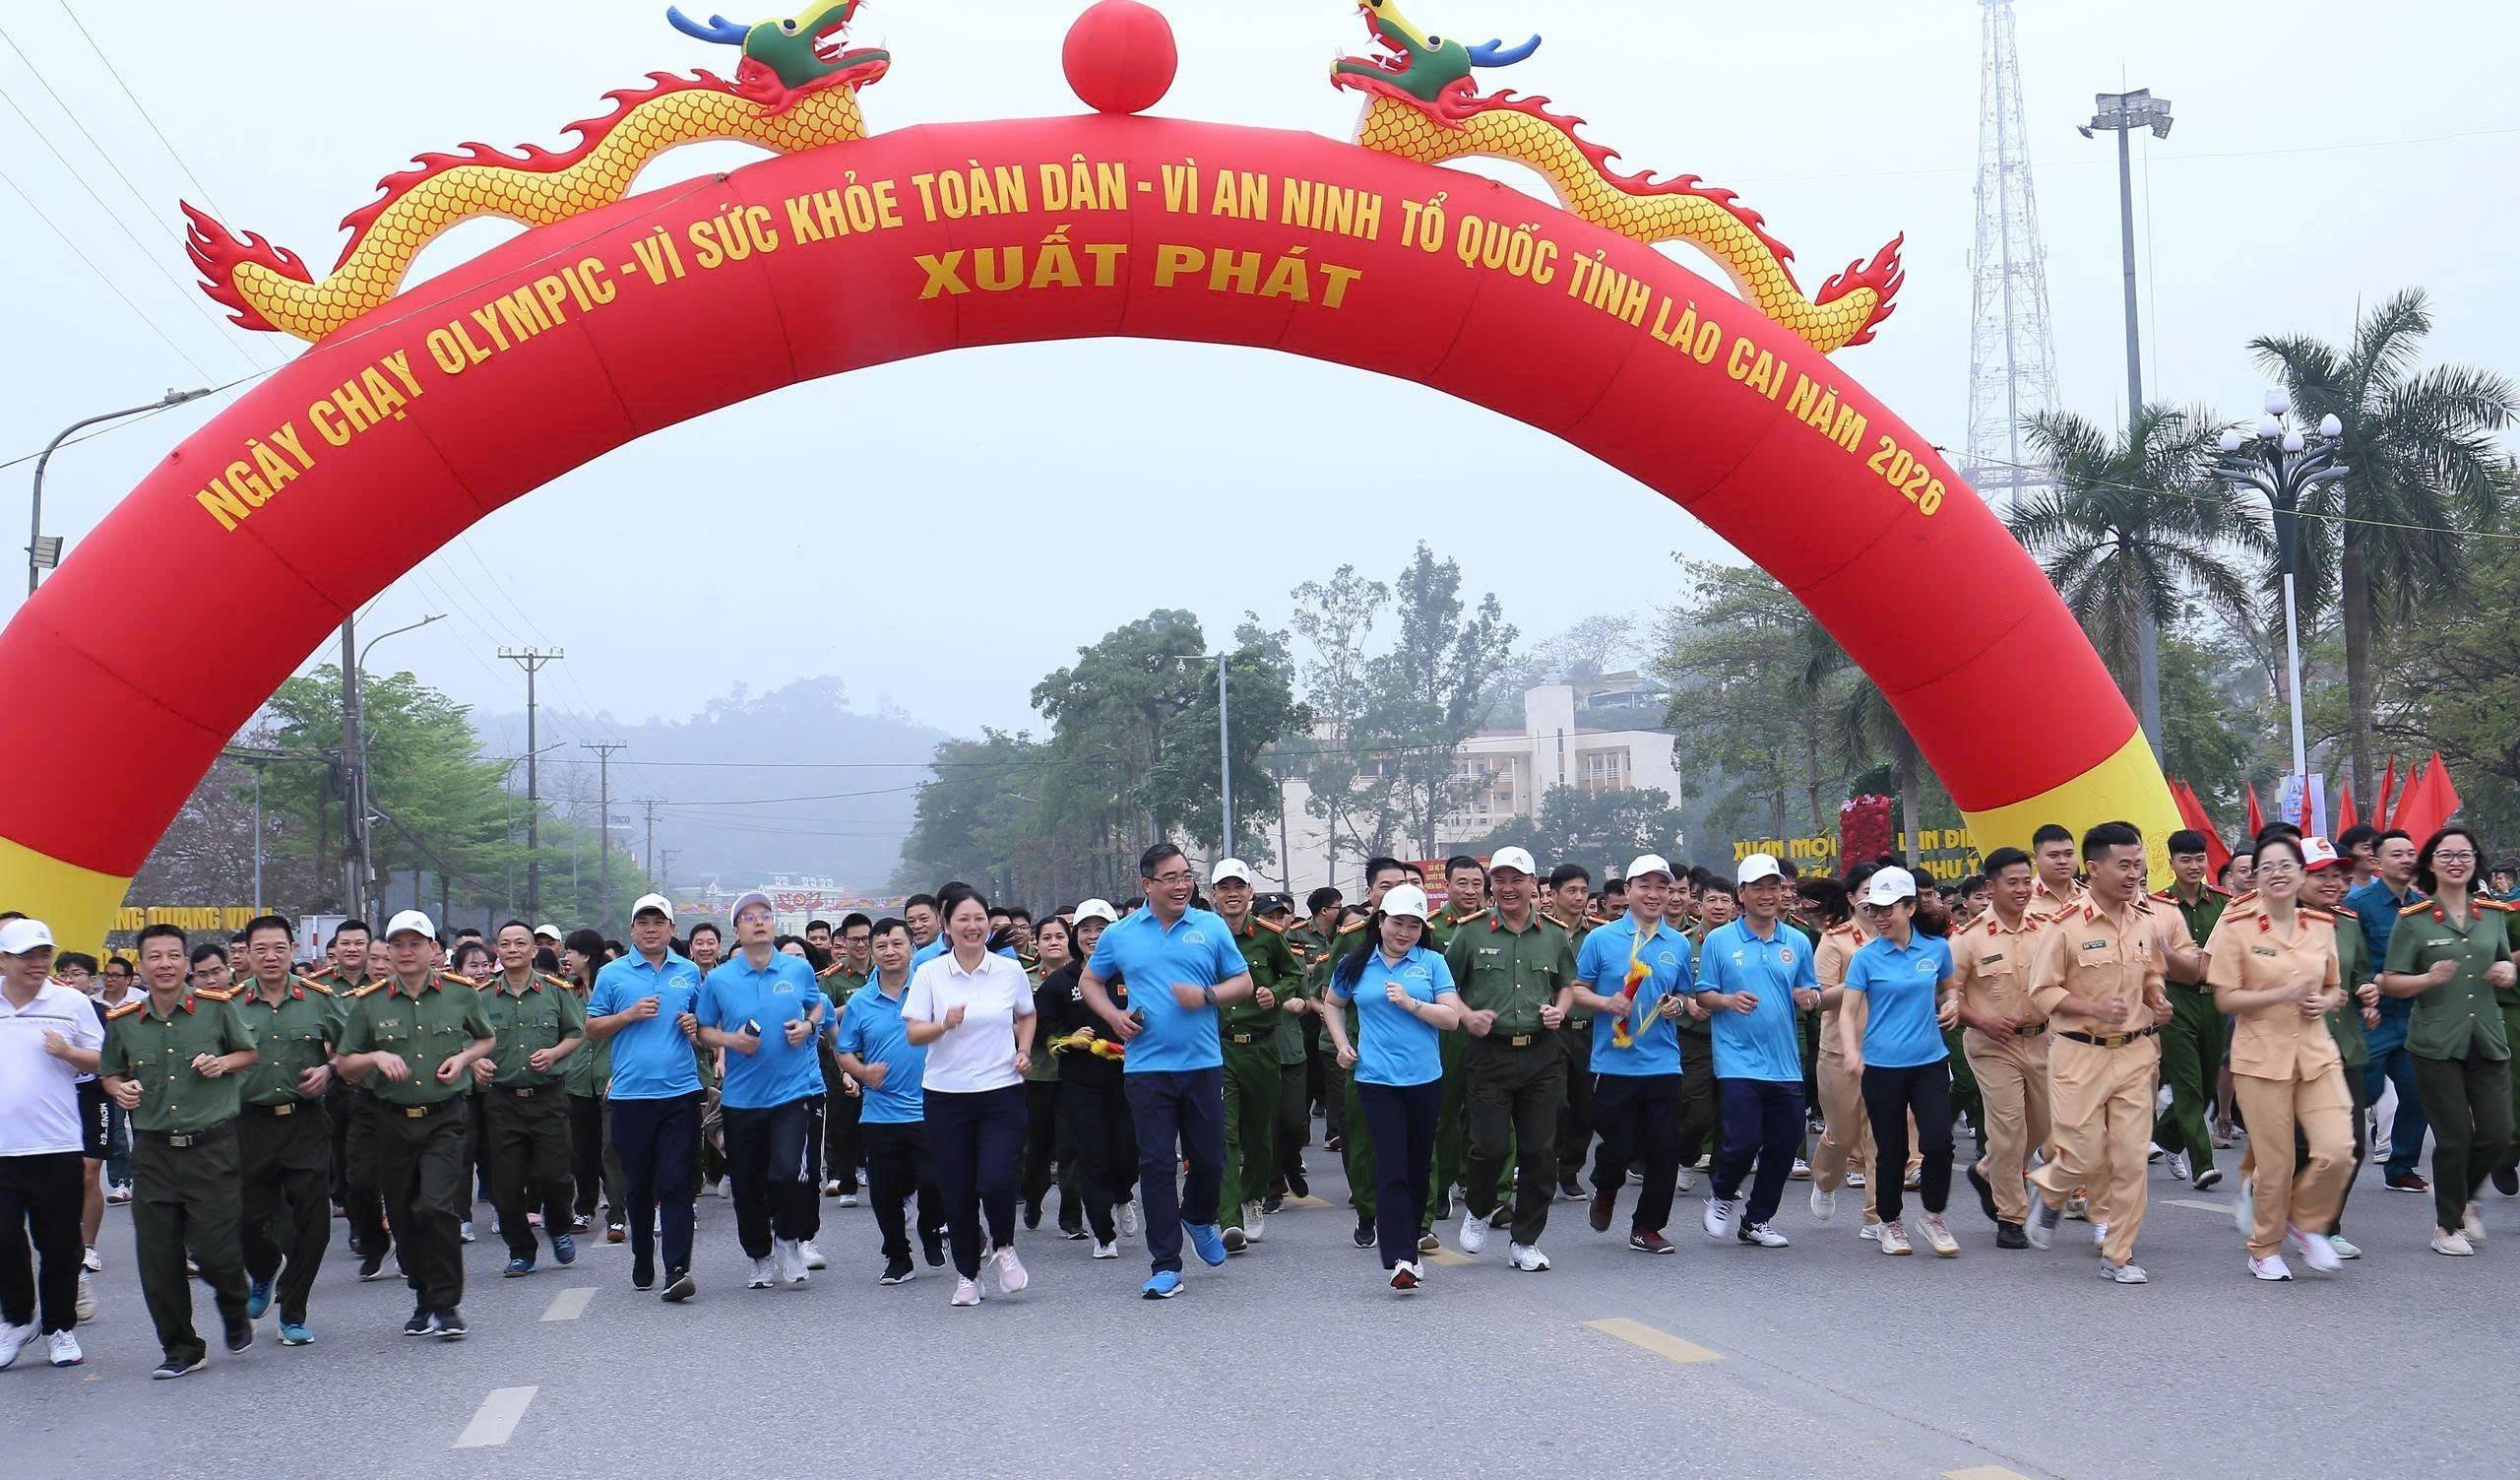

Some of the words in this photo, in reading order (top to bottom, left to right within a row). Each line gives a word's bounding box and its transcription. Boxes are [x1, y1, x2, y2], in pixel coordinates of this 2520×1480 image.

[913, 225, 1128, 300] XUẤT
[1154, 245, 1362, 309] PHÁT
[195, 420, 316, 533] NGÀY
[307, 349, 424, 447] CHẠY
[424, 257, 617, 375] OLYMPIC
[688, 202, 780, 271] SỨC
[785, 169, 904, 245] KHỎE
[911, 158, 1028, 223] TOÀN
[1040, 154, 1128, 214] DÂN
[1160, 158, 1198, 215] VÌ
[1211, 168, 1270, 222] AN
[1281, 176, 1383, 242] NINH
[1399, 190, 1449, 254] TỔ
[1457, 221, 1558, 286] QUỐC
[1567, 248, 1652, 328] TỈNH
[1650, 297, 1723, 365] LÀO
[1726, 337, 1789, 402] CAI
[1785, 372, 1869, 454] NĂM
[1866, 434, 1946, 517] 2026
[1732, 836, 1784, 862] XUÂN
[1790, 827, 1837, 859] MỚI
